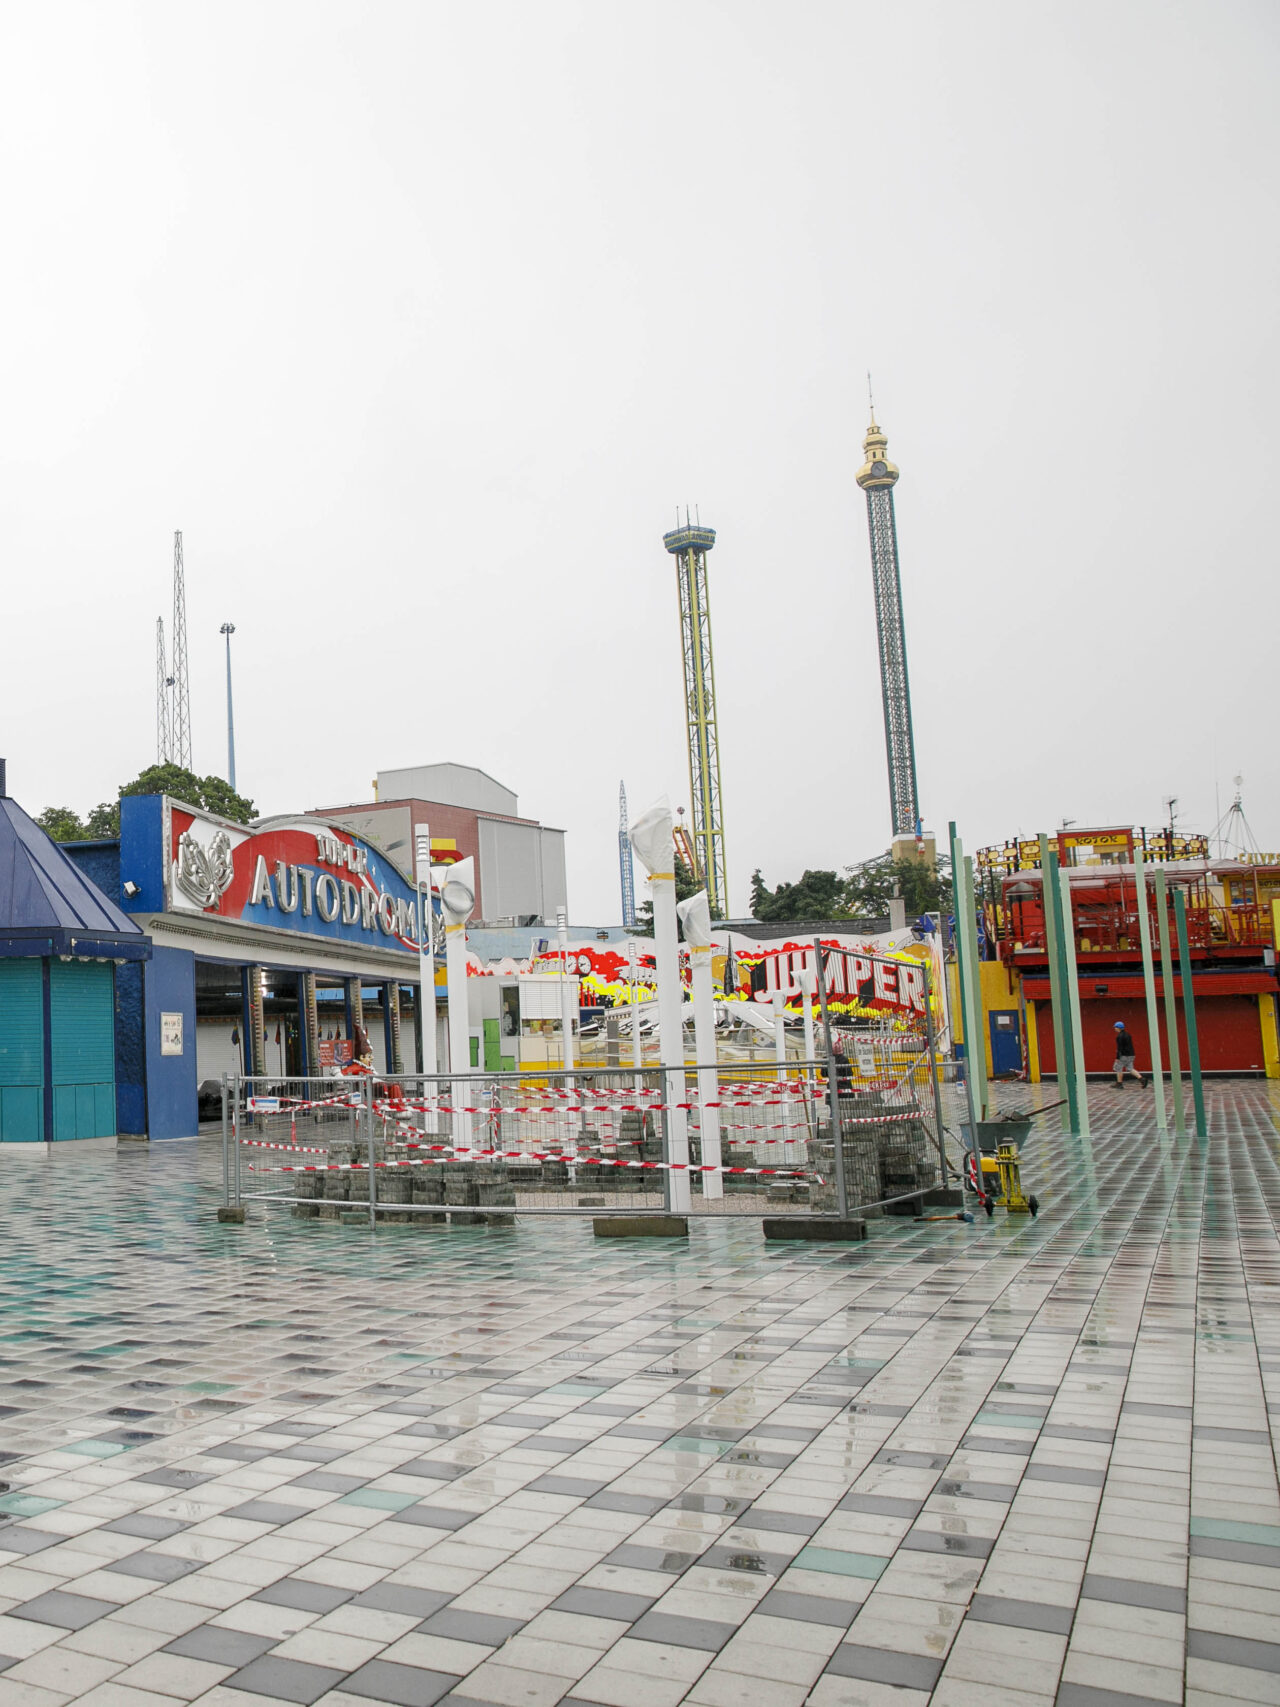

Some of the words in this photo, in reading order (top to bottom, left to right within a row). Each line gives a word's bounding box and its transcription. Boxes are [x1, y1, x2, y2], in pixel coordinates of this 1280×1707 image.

[316, 834, 368, 876] SUPER
[1074, 834, 1118, 845] ROTOR
[248, 854, 418, 940] AUTODROM
[754, 950, 927, 1013] JUMPER
